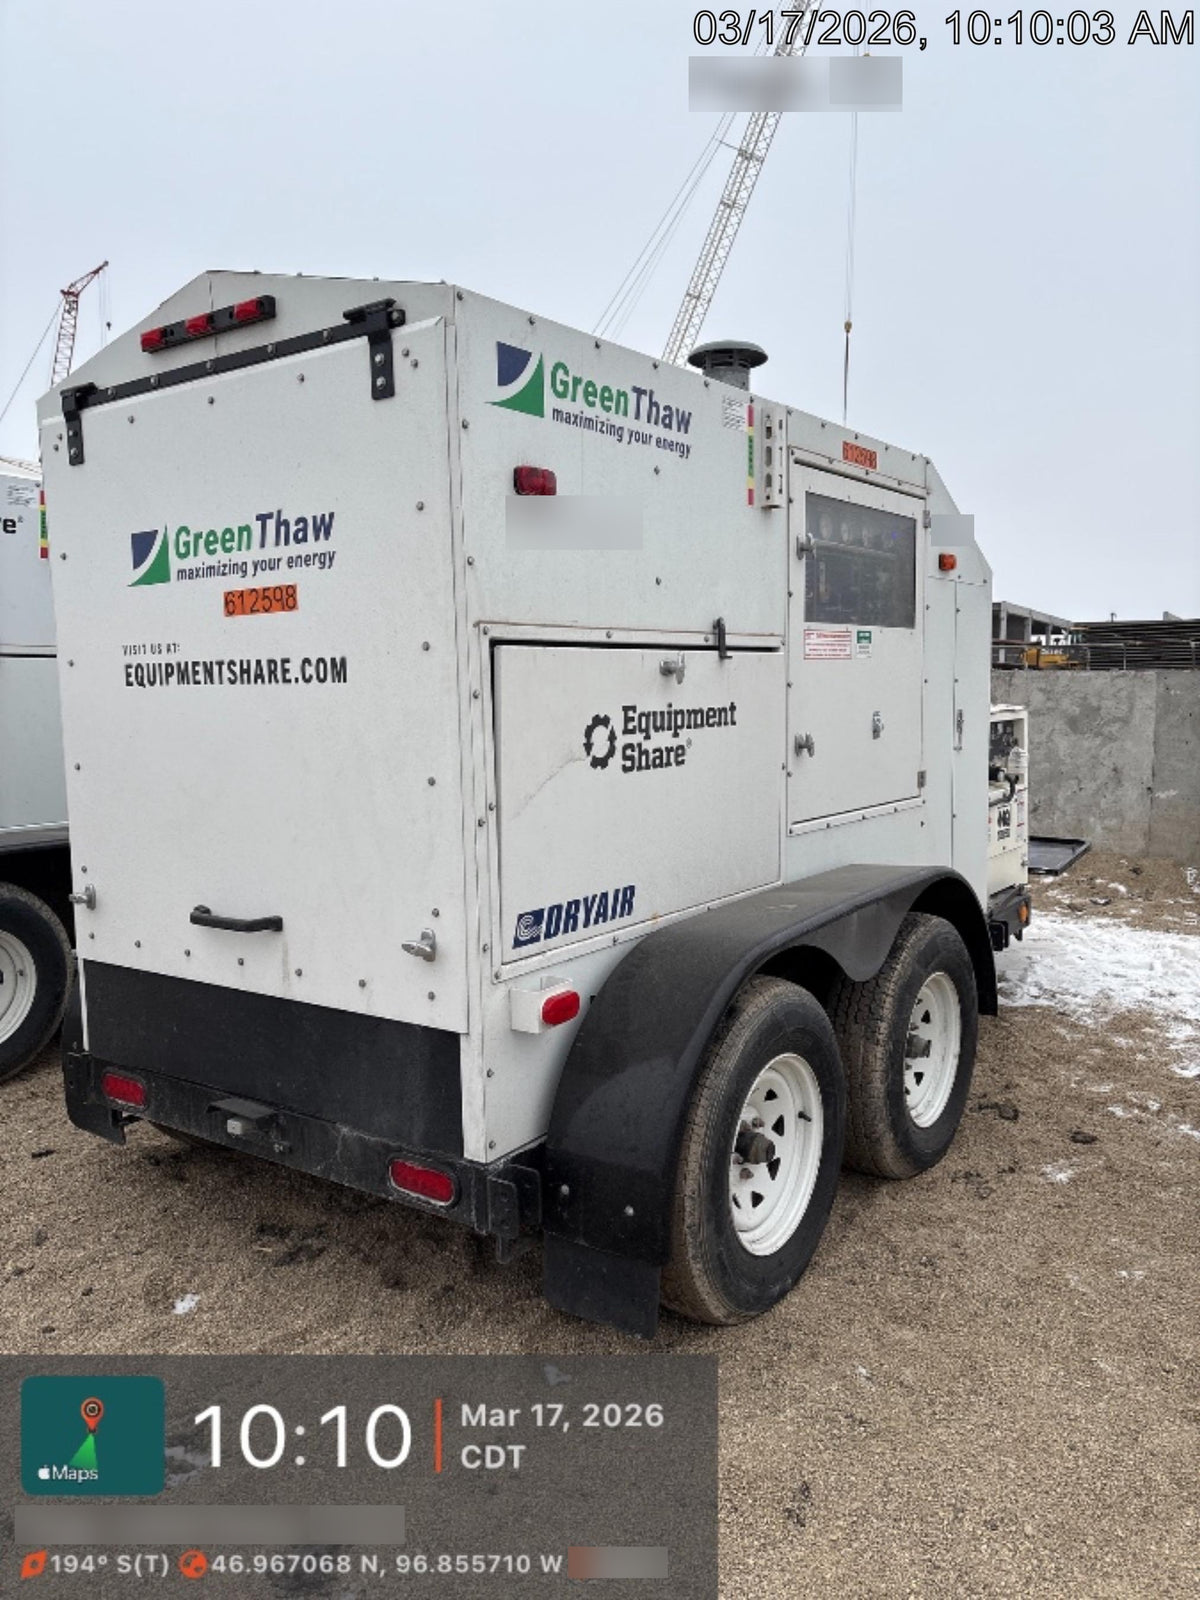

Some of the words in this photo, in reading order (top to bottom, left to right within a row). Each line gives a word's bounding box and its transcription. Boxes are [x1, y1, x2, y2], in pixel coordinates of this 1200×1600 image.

[551, 361, 692, 435] GreenThaw
[552, 407, 625, 443] maximizing
[627, 426, 654, 445] your
[655, 436, 692, 460] energy
[174, 508, 336, 560] GreenThaw
[176, 558, 248, 581] maximizing
[252, 555, 282, 577] your
[287, 550, 336, 570] energy
[224, 584, 297, 616] 612598
[121, 644, 147, 656] VISIT
[150, 643, 163, 655] US
[166, 643, 181, 655] AT:
[124, 656, 348, 689] EQUIPMENTSHARE.COM
[621, 701, 737, 741] Equipment
[544, 885, 636, 941] DRYAIR
